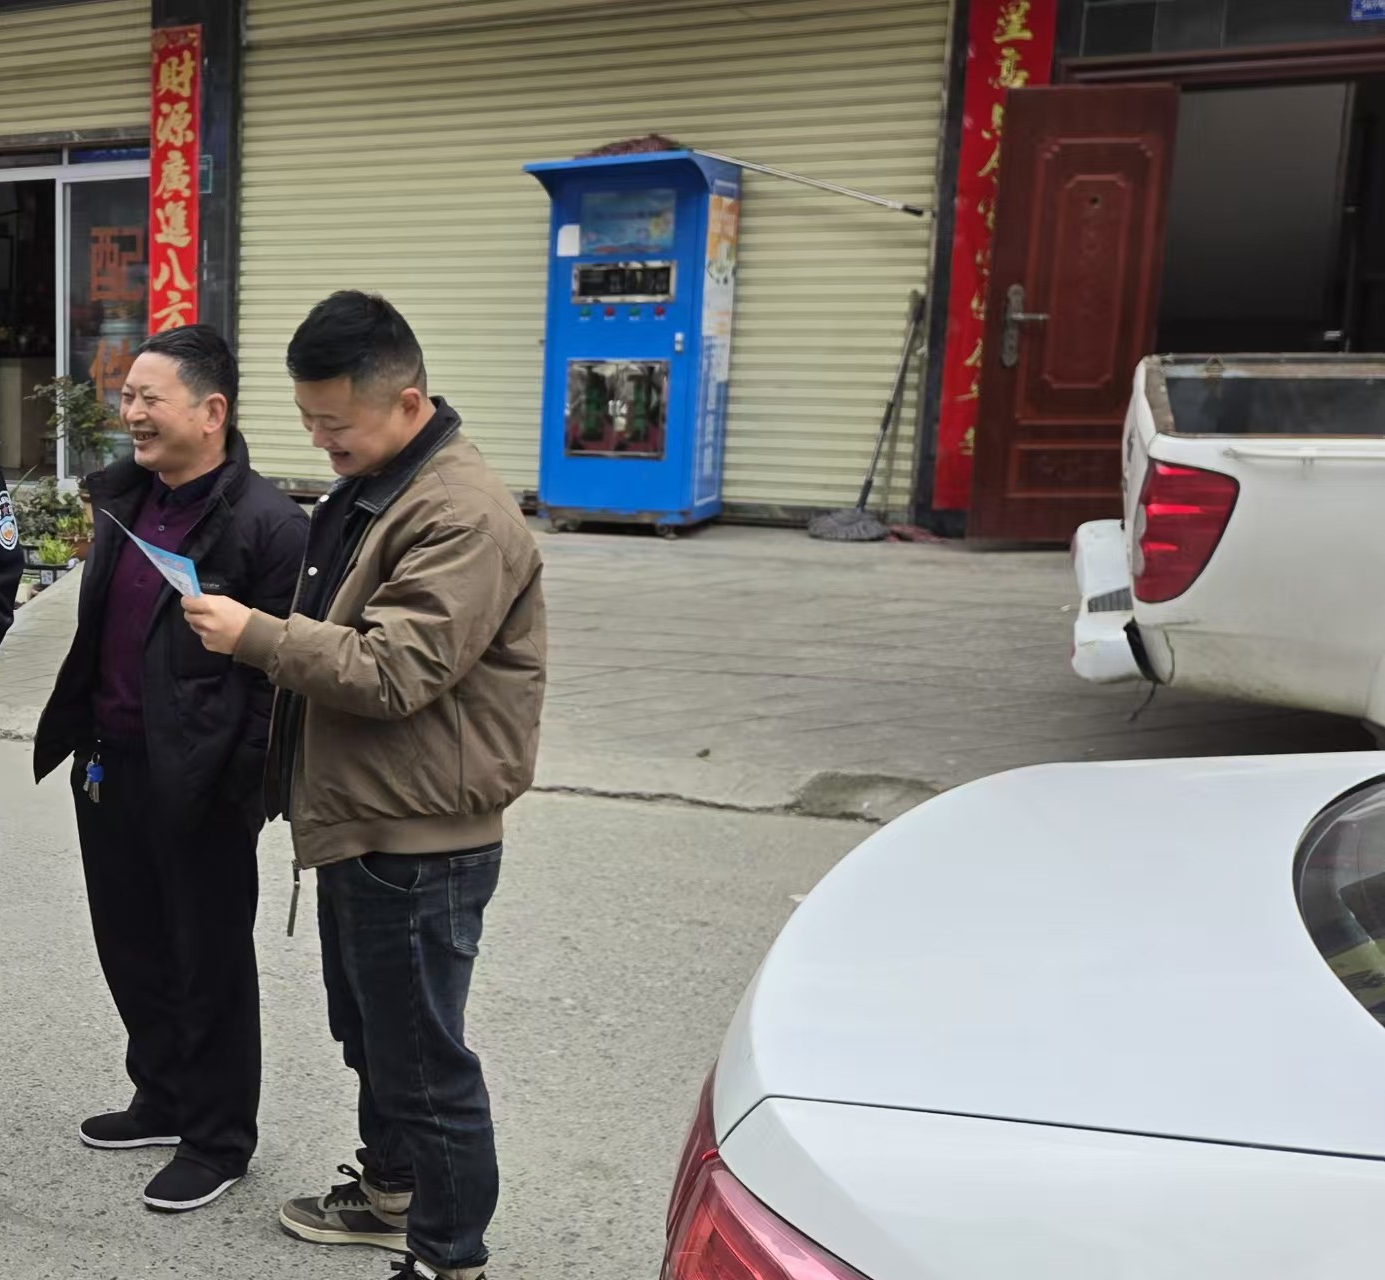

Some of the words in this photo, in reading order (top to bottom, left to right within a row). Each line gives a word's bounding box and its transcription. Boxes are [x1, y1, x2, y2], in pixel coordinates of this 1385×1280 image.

[152, 51, 196, 331] 財源廣進八方
